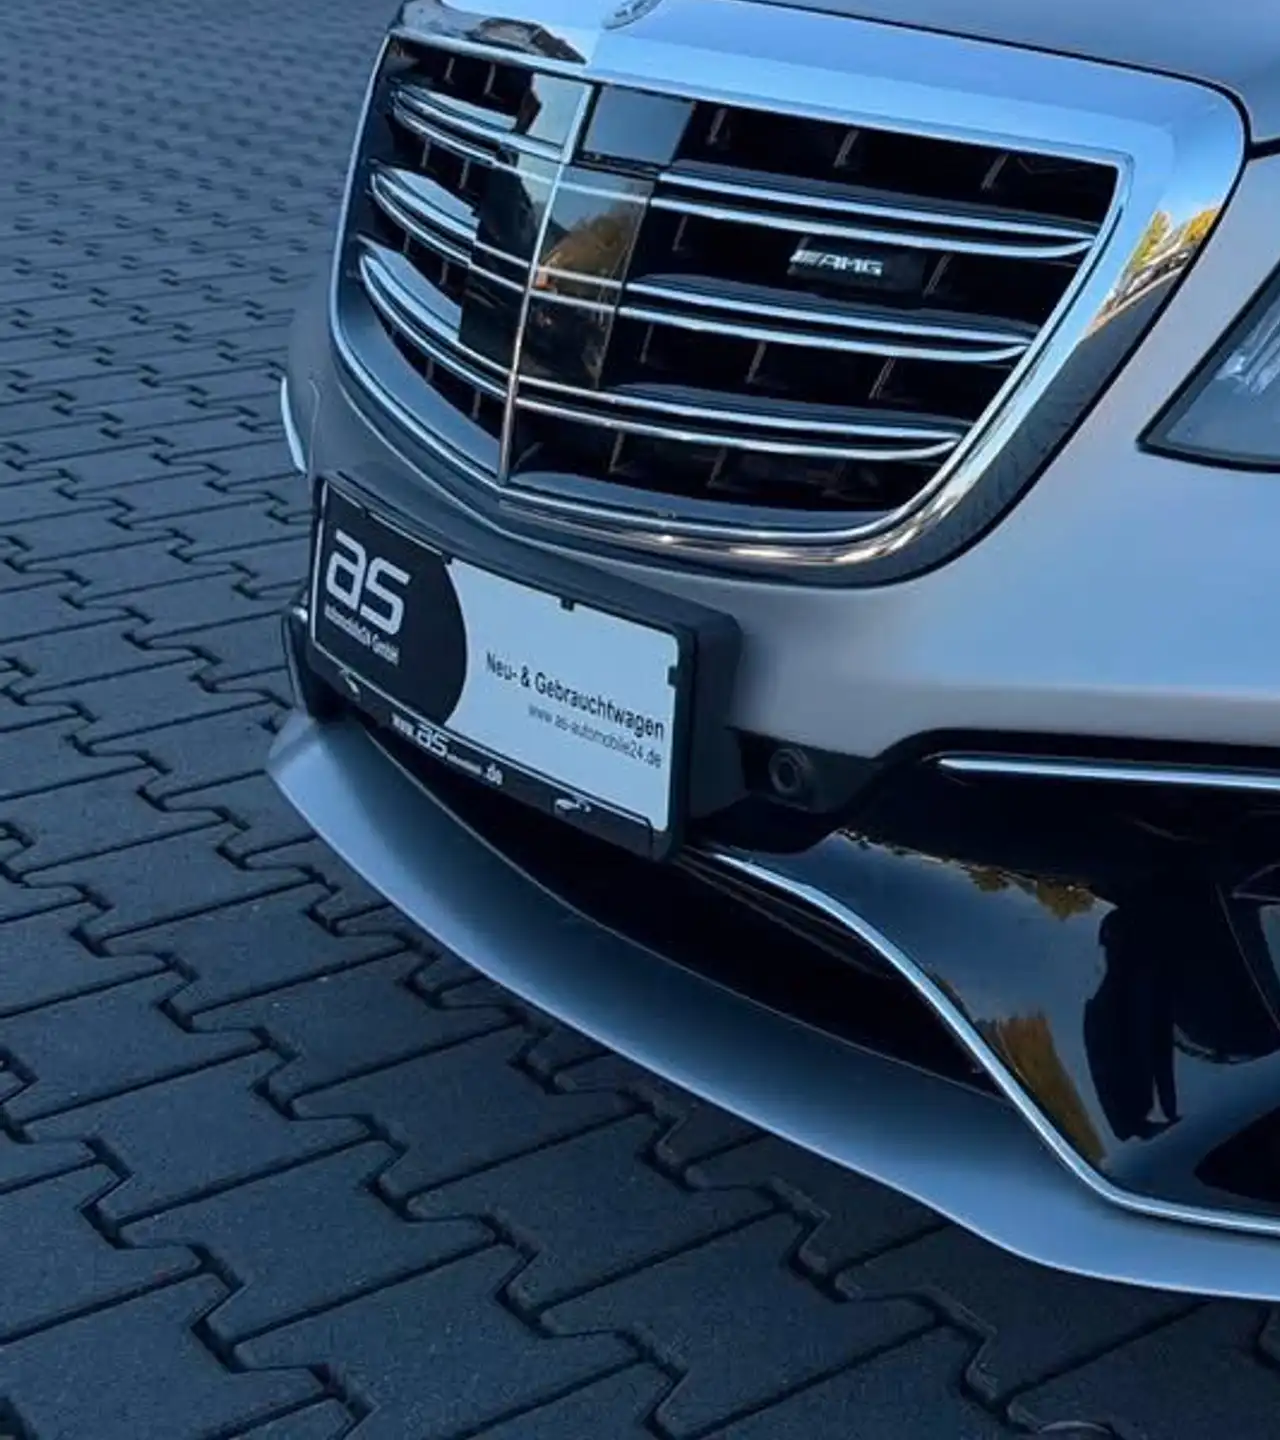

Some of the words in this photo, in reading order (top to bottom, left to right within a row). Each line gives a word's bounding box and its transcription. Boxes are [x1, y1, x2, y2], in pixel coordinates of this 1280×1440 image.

[818, 252, 884, 277] AMG
[326, 528, 411, 636] as
[486, 650, 518, 681] Neu-
[520, 665, 531, 688] &
[534, 671, 665, 741] Gebrauchtwagen
